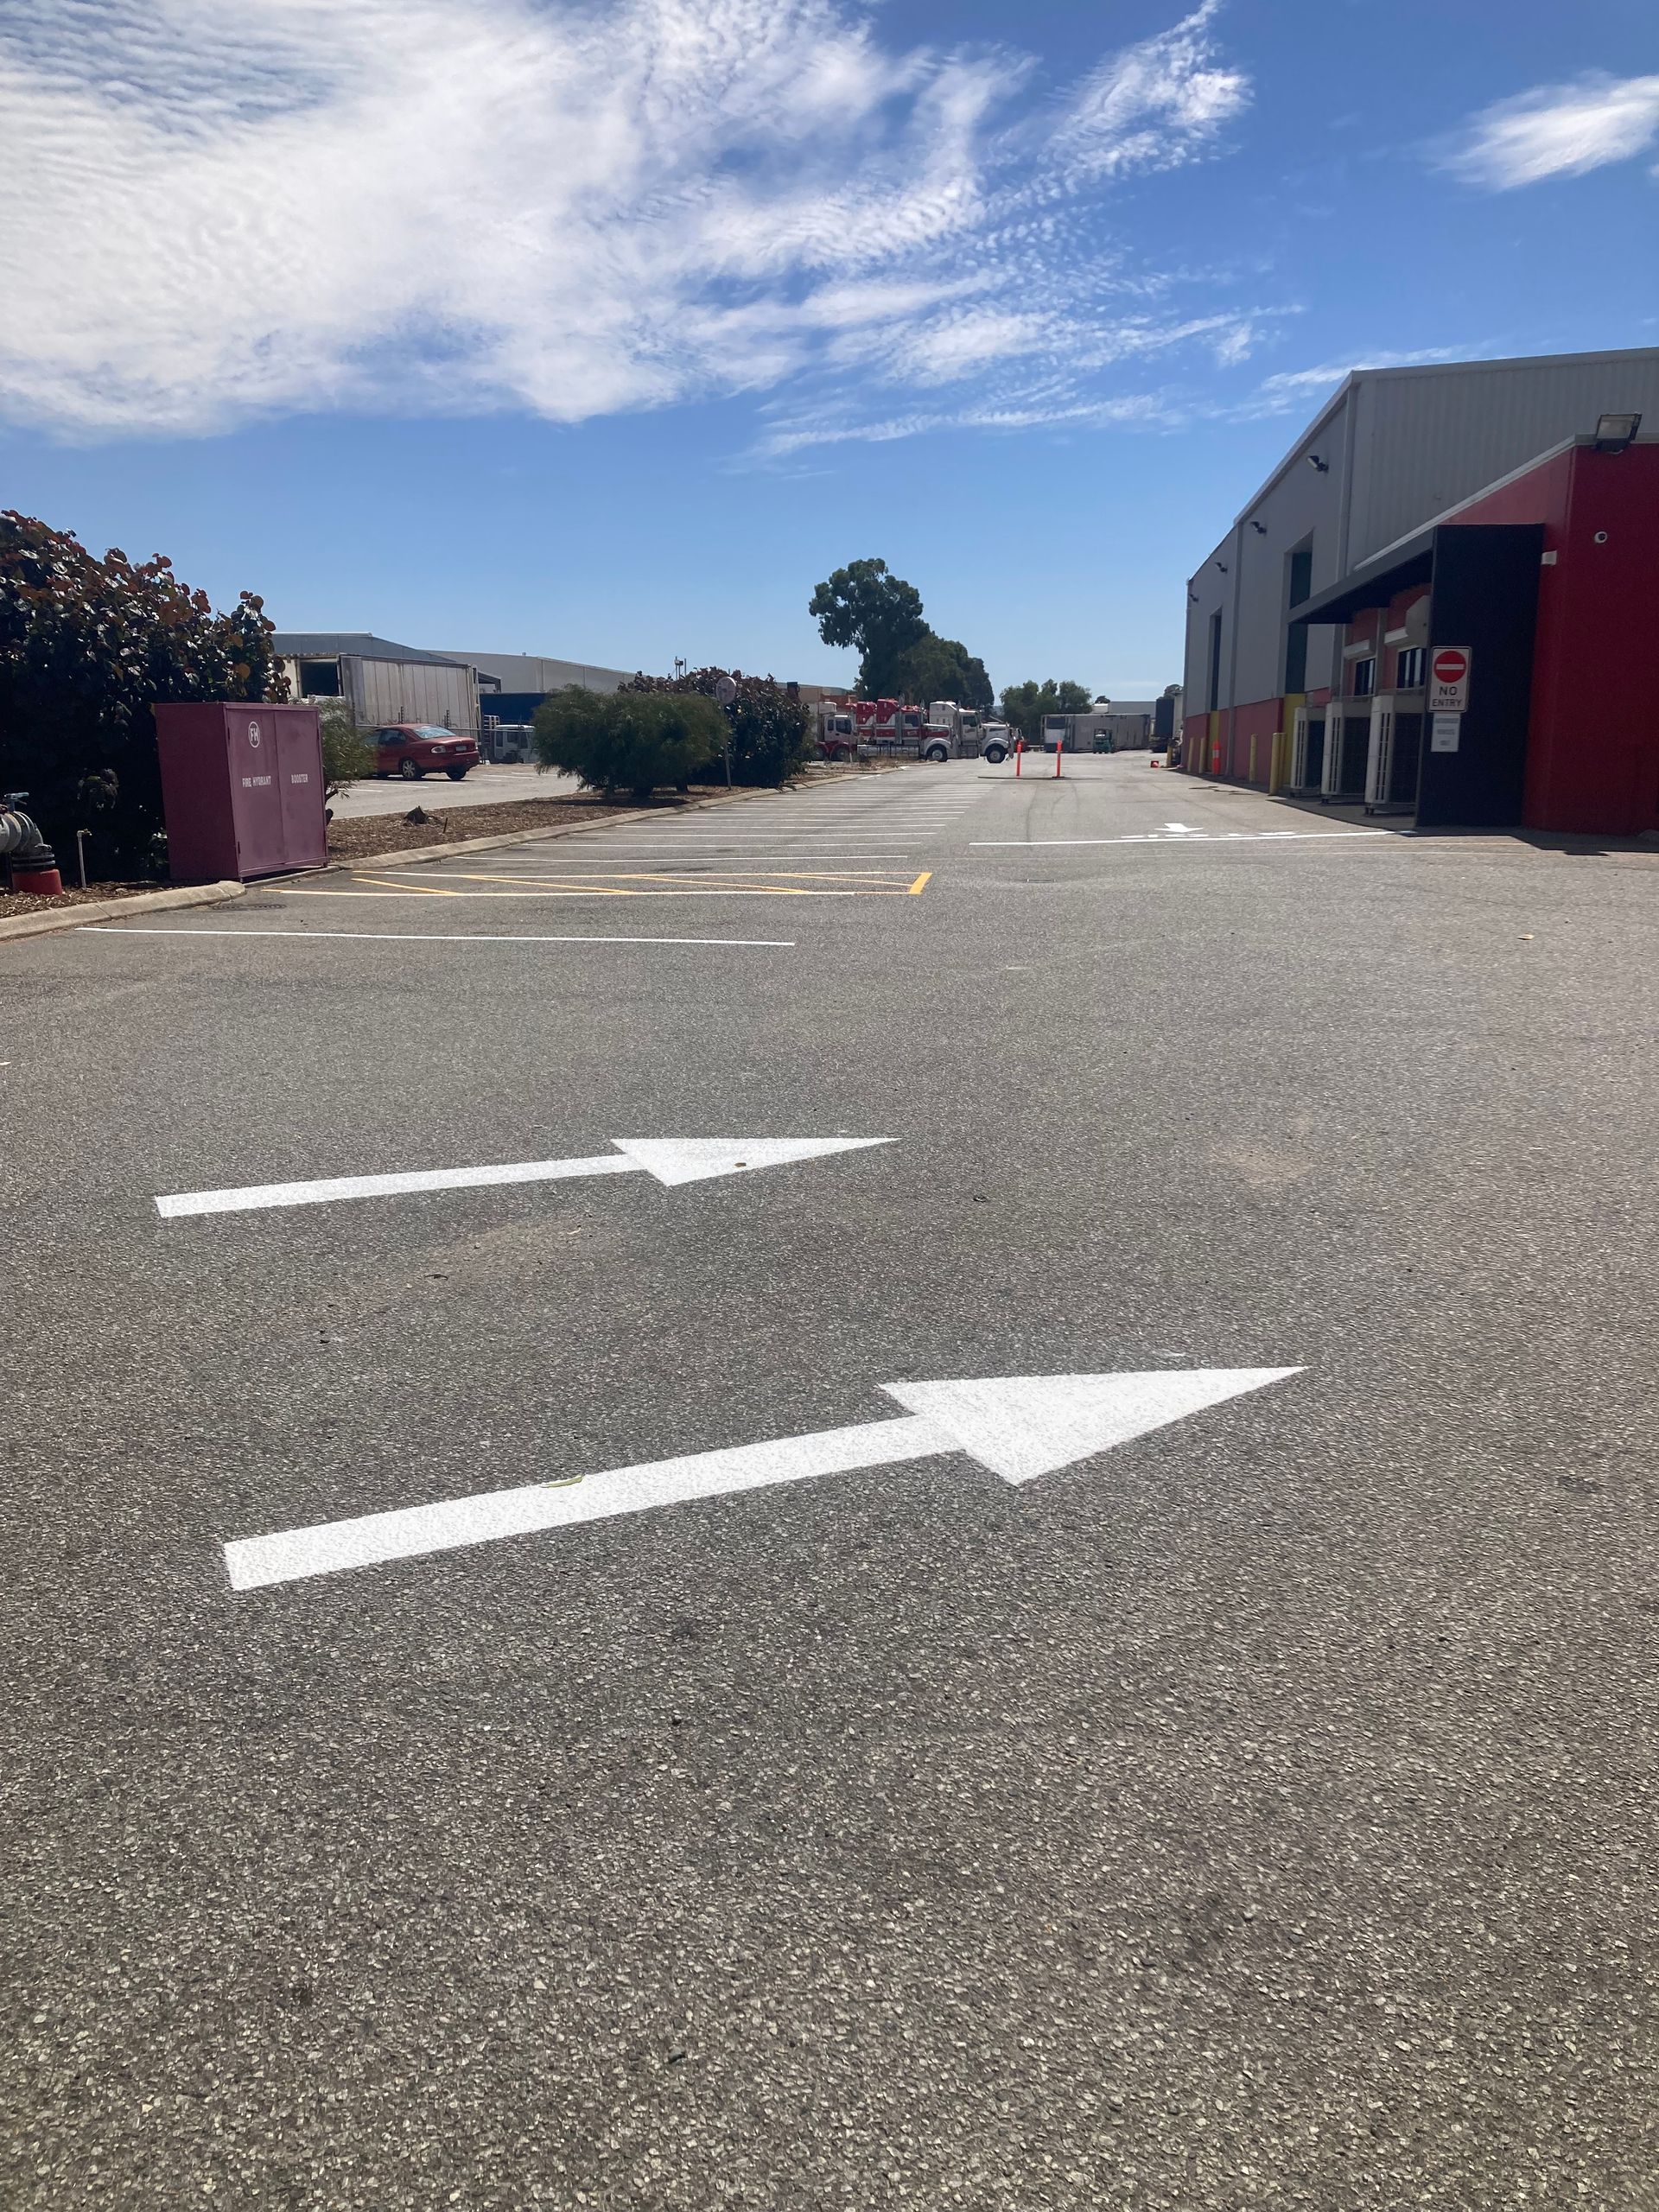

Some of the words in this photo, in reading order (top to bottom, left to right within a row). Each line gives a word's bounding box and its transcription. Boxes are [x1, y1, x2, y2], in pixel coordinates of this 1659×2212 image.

[1440, 686, 1458, 696] NO
[1432, 698, 1463, 707] ENTRY
[250, 728, 258, 741] FH
[242, 777, 251, 787] FIRE
[252, 775, 271, 786] HYDRANT
[291, 773, 308, 784] BOOSTER
